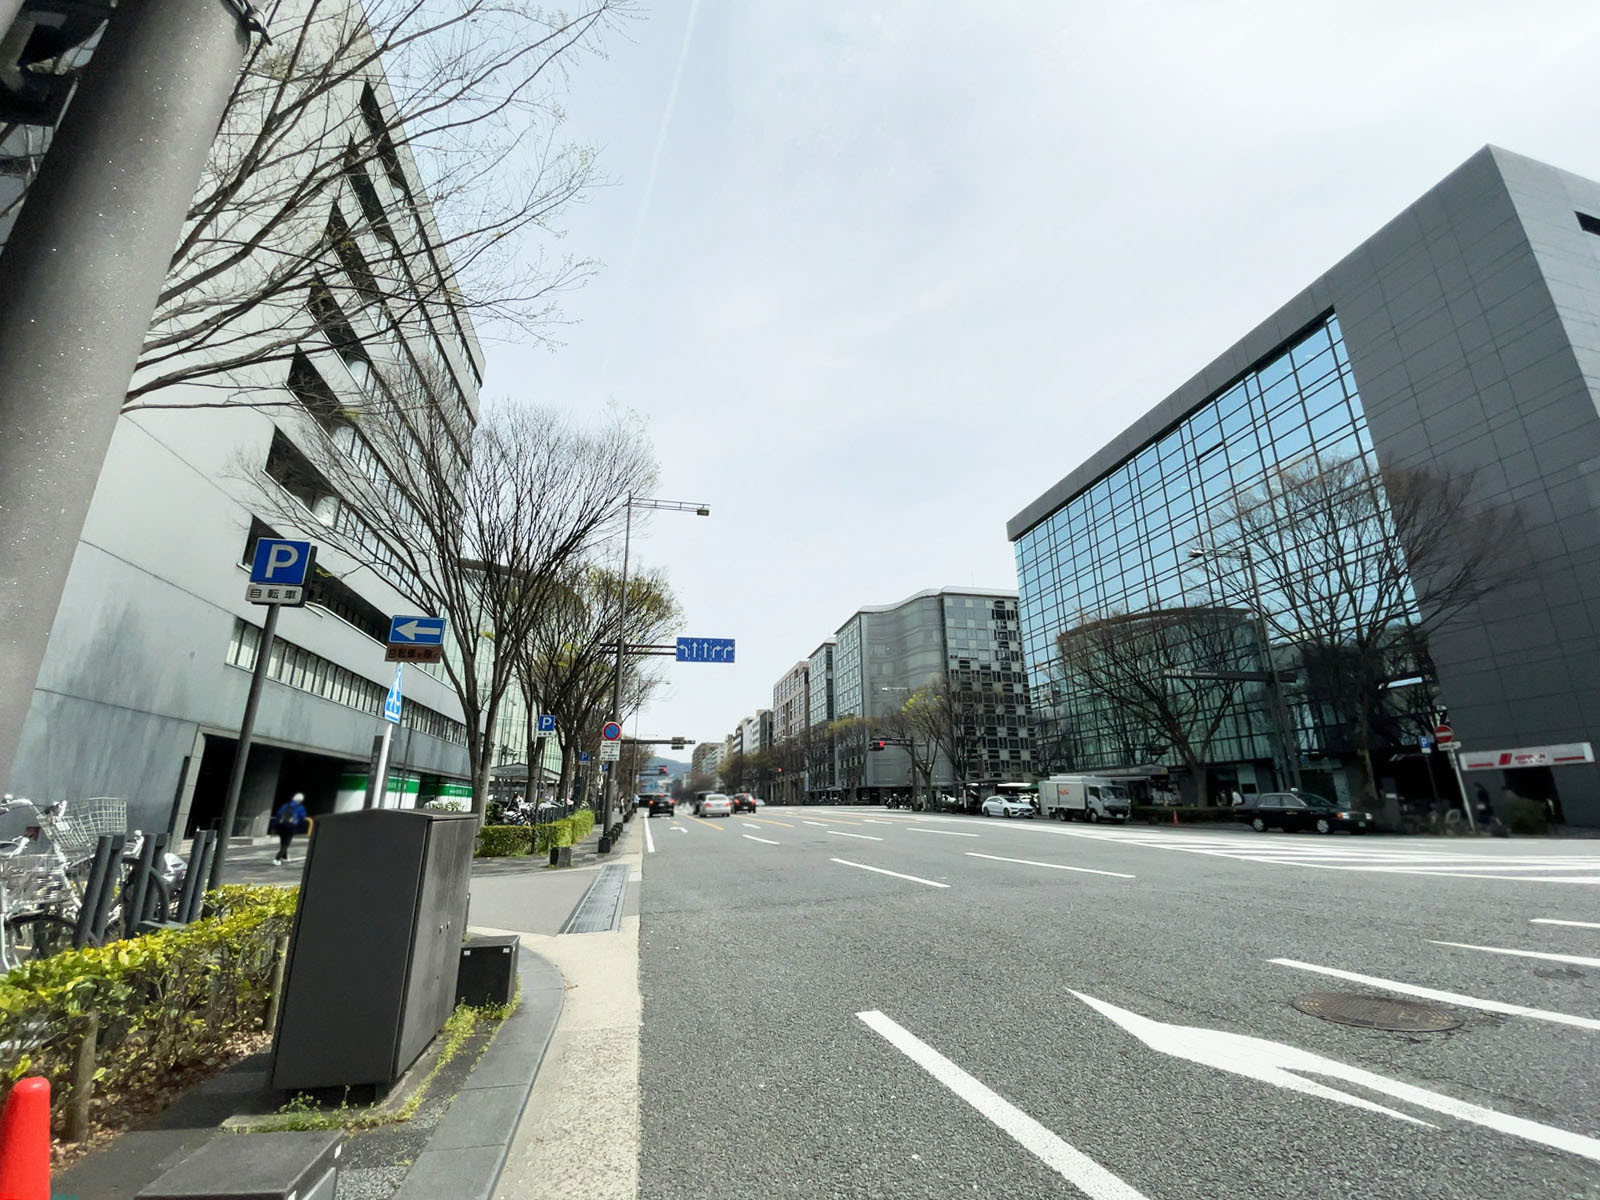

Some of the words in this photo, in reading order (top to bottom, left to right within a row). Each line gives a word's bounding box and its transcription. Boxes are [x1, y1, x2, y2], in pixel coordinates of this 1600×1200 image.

[264, 543, 299, 579] P
[250, 588, 297, 600] 自転車
[542, 717, 552, 729] P
